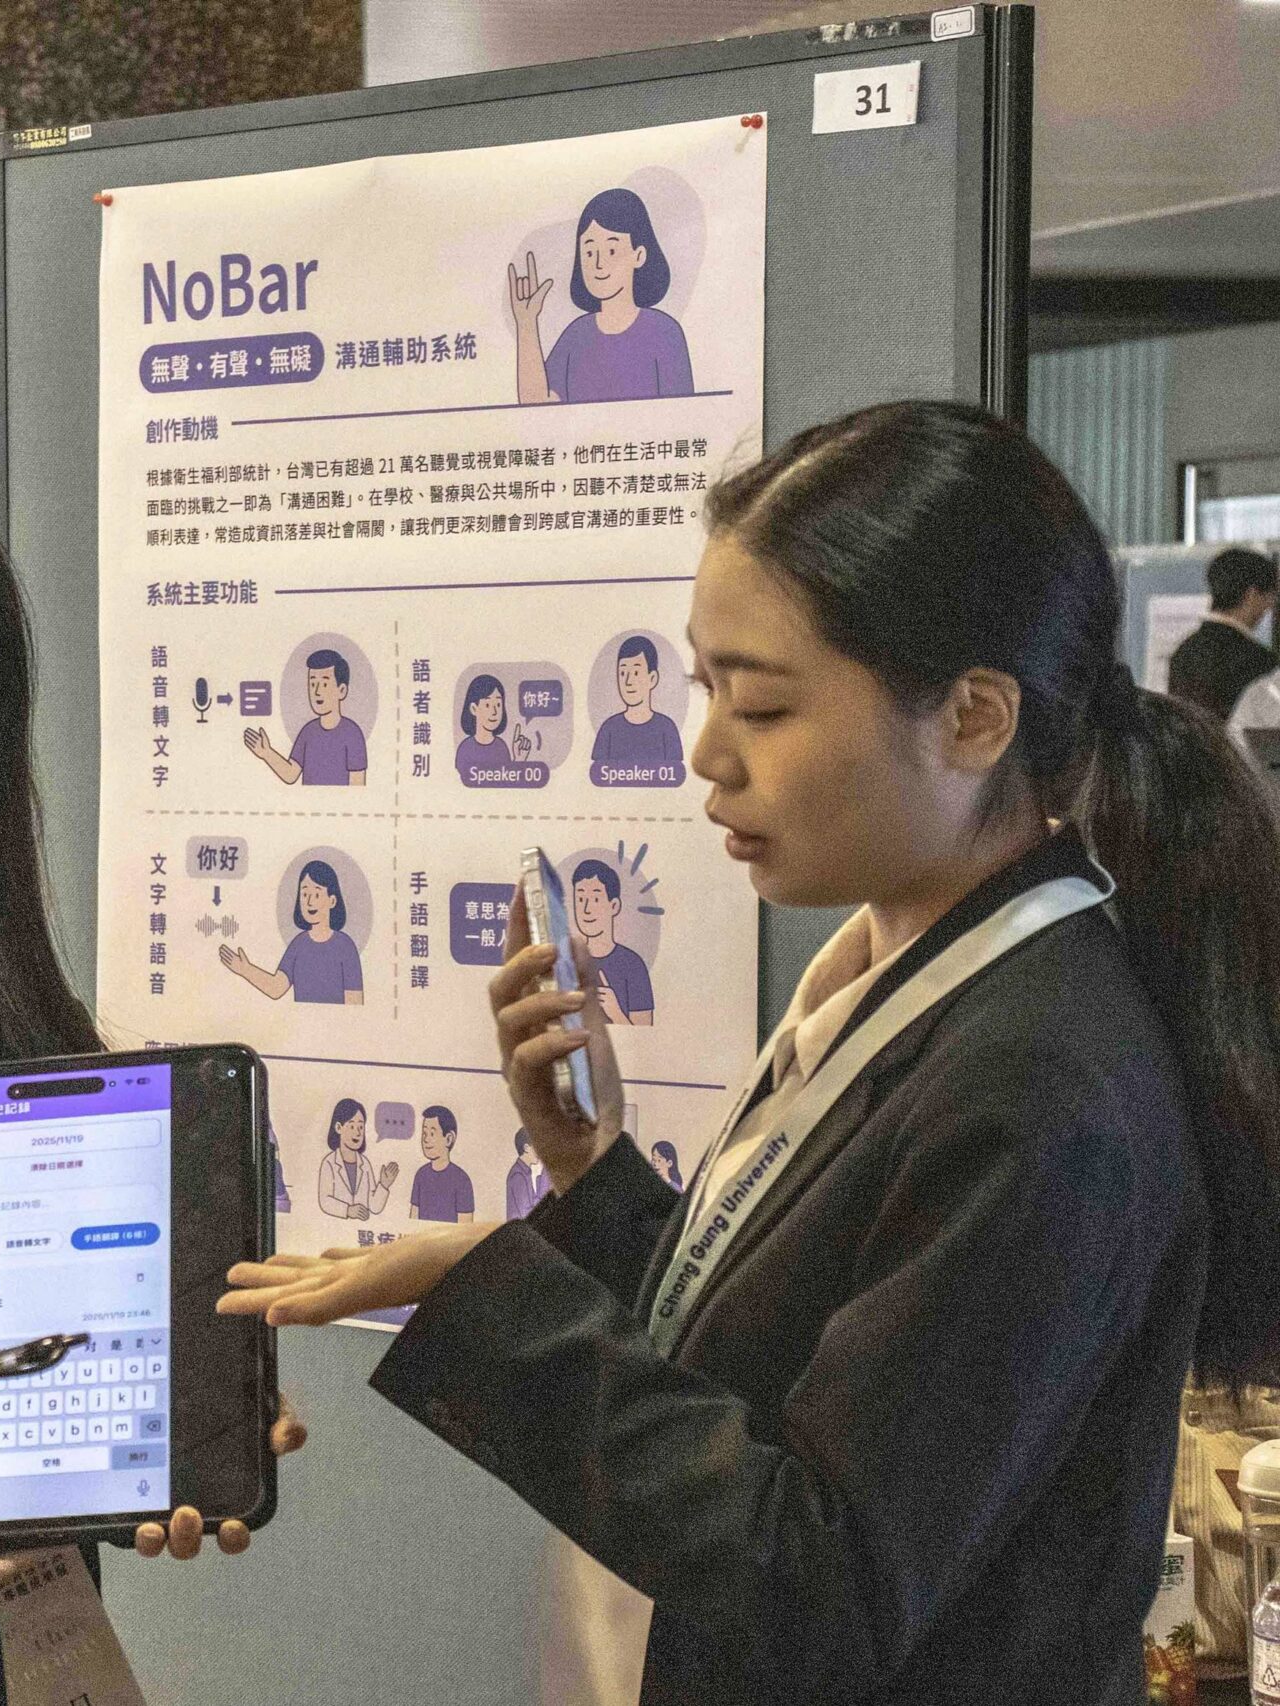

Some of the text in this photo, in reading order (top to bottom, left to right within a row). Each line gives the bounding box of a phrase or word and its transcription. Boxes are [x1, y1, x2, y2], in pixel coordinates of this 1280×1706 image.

[854, 82, 891, 117] 31
[142, 252, 318, 324] NoBar
[335, 331, 477, 370] 溝通輔助系統
[145, 415, 219, 444] 創作動機
[146, 438, 708, 487] 根據衛生福利部統計，台灣已有超過 21 萬名聽覺或視覺障礙者，他們在生活中最常
[146, 579, 259, 607] 系統主要功能
[151, 645, 170, 788] 語音轉文字
[411, 659, 432, 778] 語者識別
[470, 765, 542, 783] Speaker 00
[600, 765, 676, 783] Speaker 01
[197, 845, 239, 872] 你好
[149, 852, 168, 995] 文字轉語音
[410, 871, 429, 990] 手語翻譯
[659, 1260, 701, 1320] Chang
[689, 1212, 730, 1260] Gung
[720, 1130, 791, 1214] University
